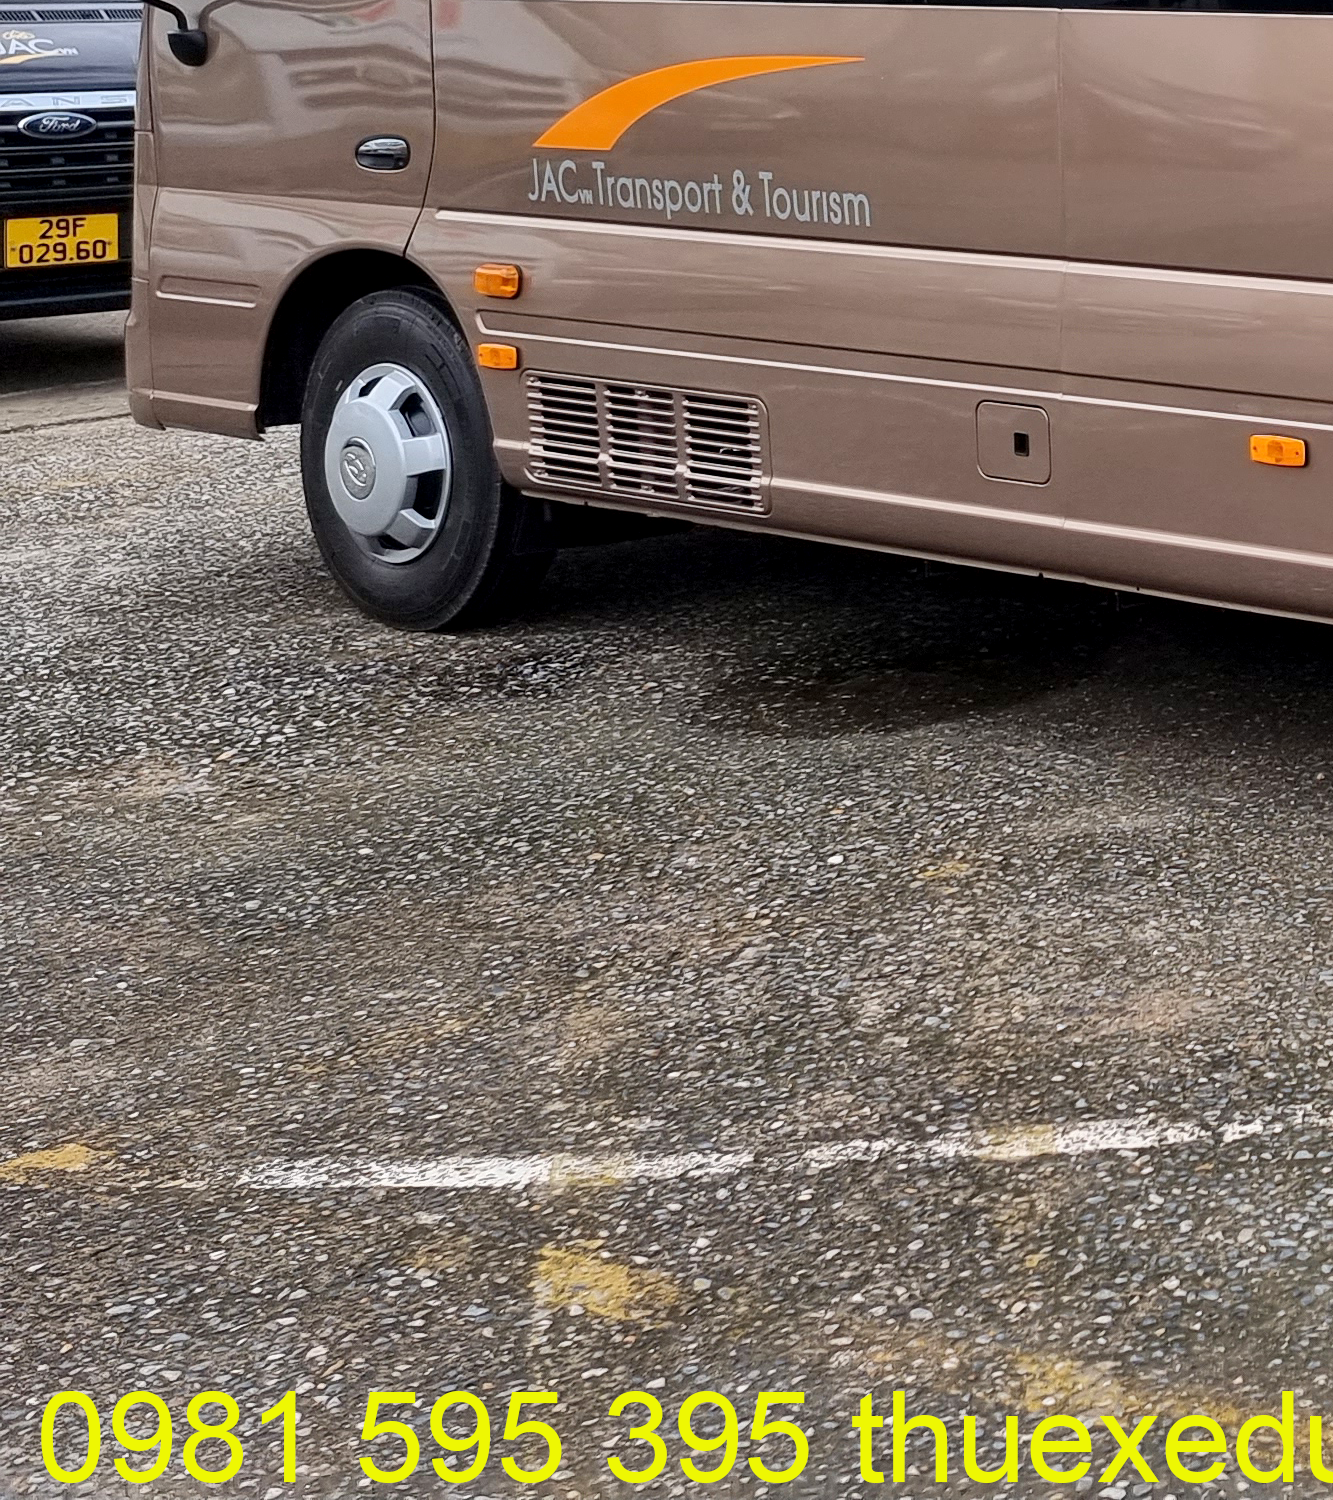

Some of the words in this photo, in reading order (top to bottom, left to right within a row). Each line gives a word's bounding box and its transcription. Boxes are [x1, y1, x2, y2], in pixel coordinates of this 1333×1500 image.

[38, 116, 81, 133] Ford
[591, 160, 724, 221] Transport
[731, 168, 754, 217] &
[758, 170, 872, 228] Tourism
[38, 217, 87, 240] 29F
[19, 239, 107, 265] 029.60
